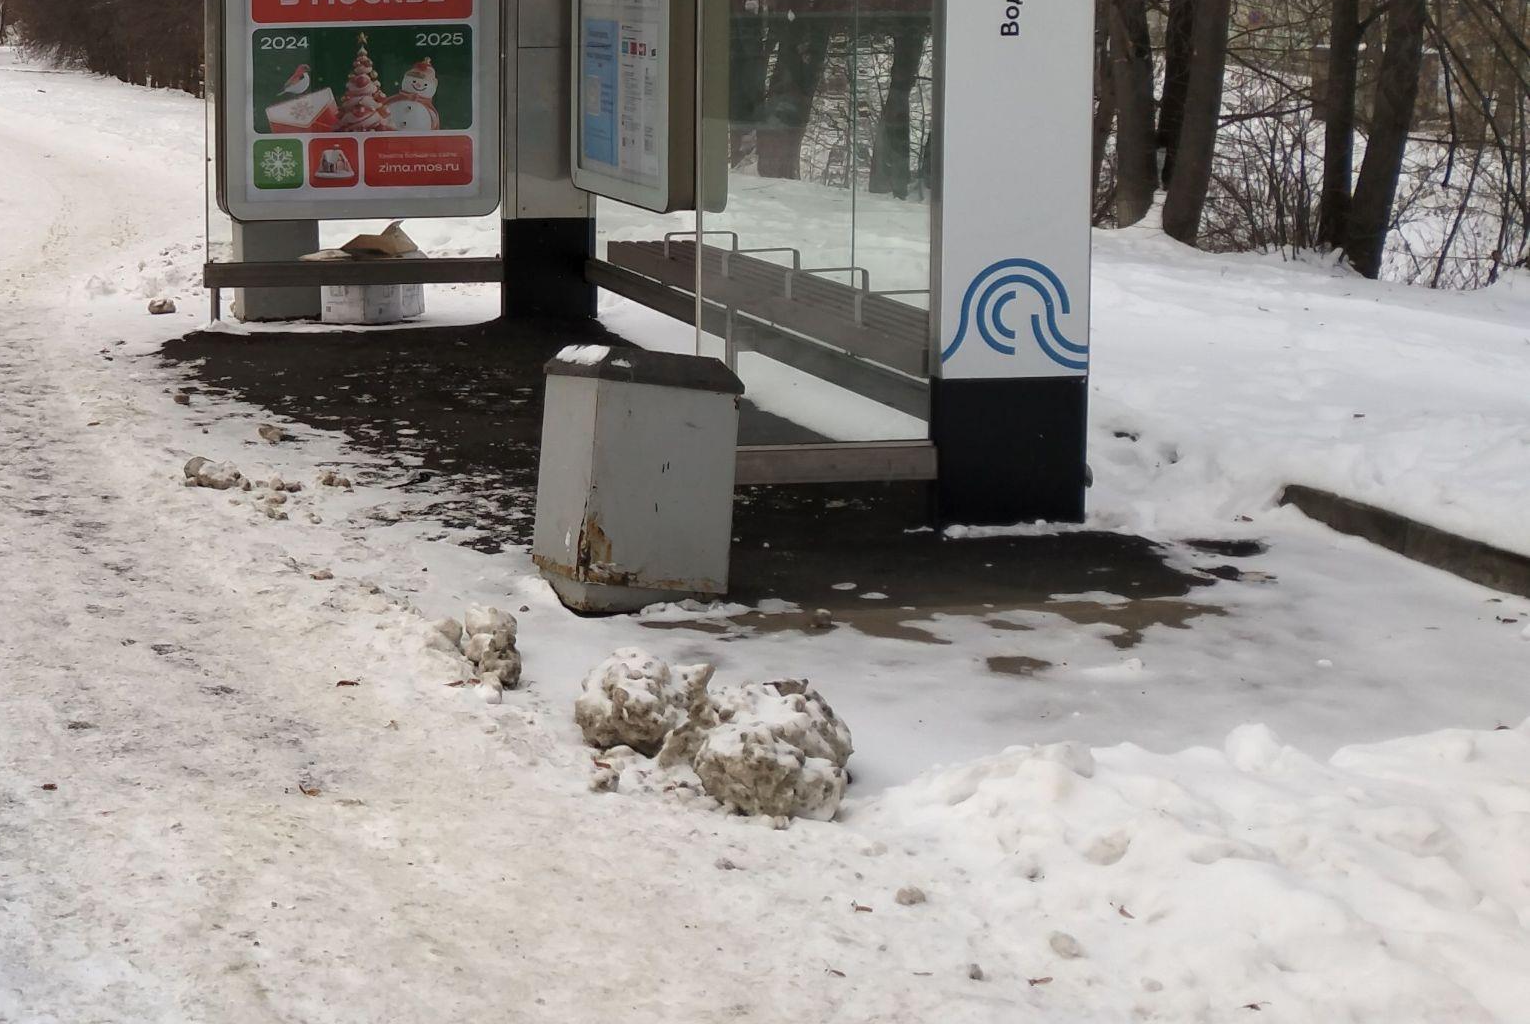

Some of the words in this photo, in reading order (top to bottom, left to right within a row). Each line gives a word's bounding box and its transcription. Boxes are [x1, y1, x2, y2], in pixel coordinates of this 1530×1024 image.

[260, 35, 310, 50] 2024
[415, 32, 464, 46] 2025
[378, 163, 460, 173] zima.mos.ru
